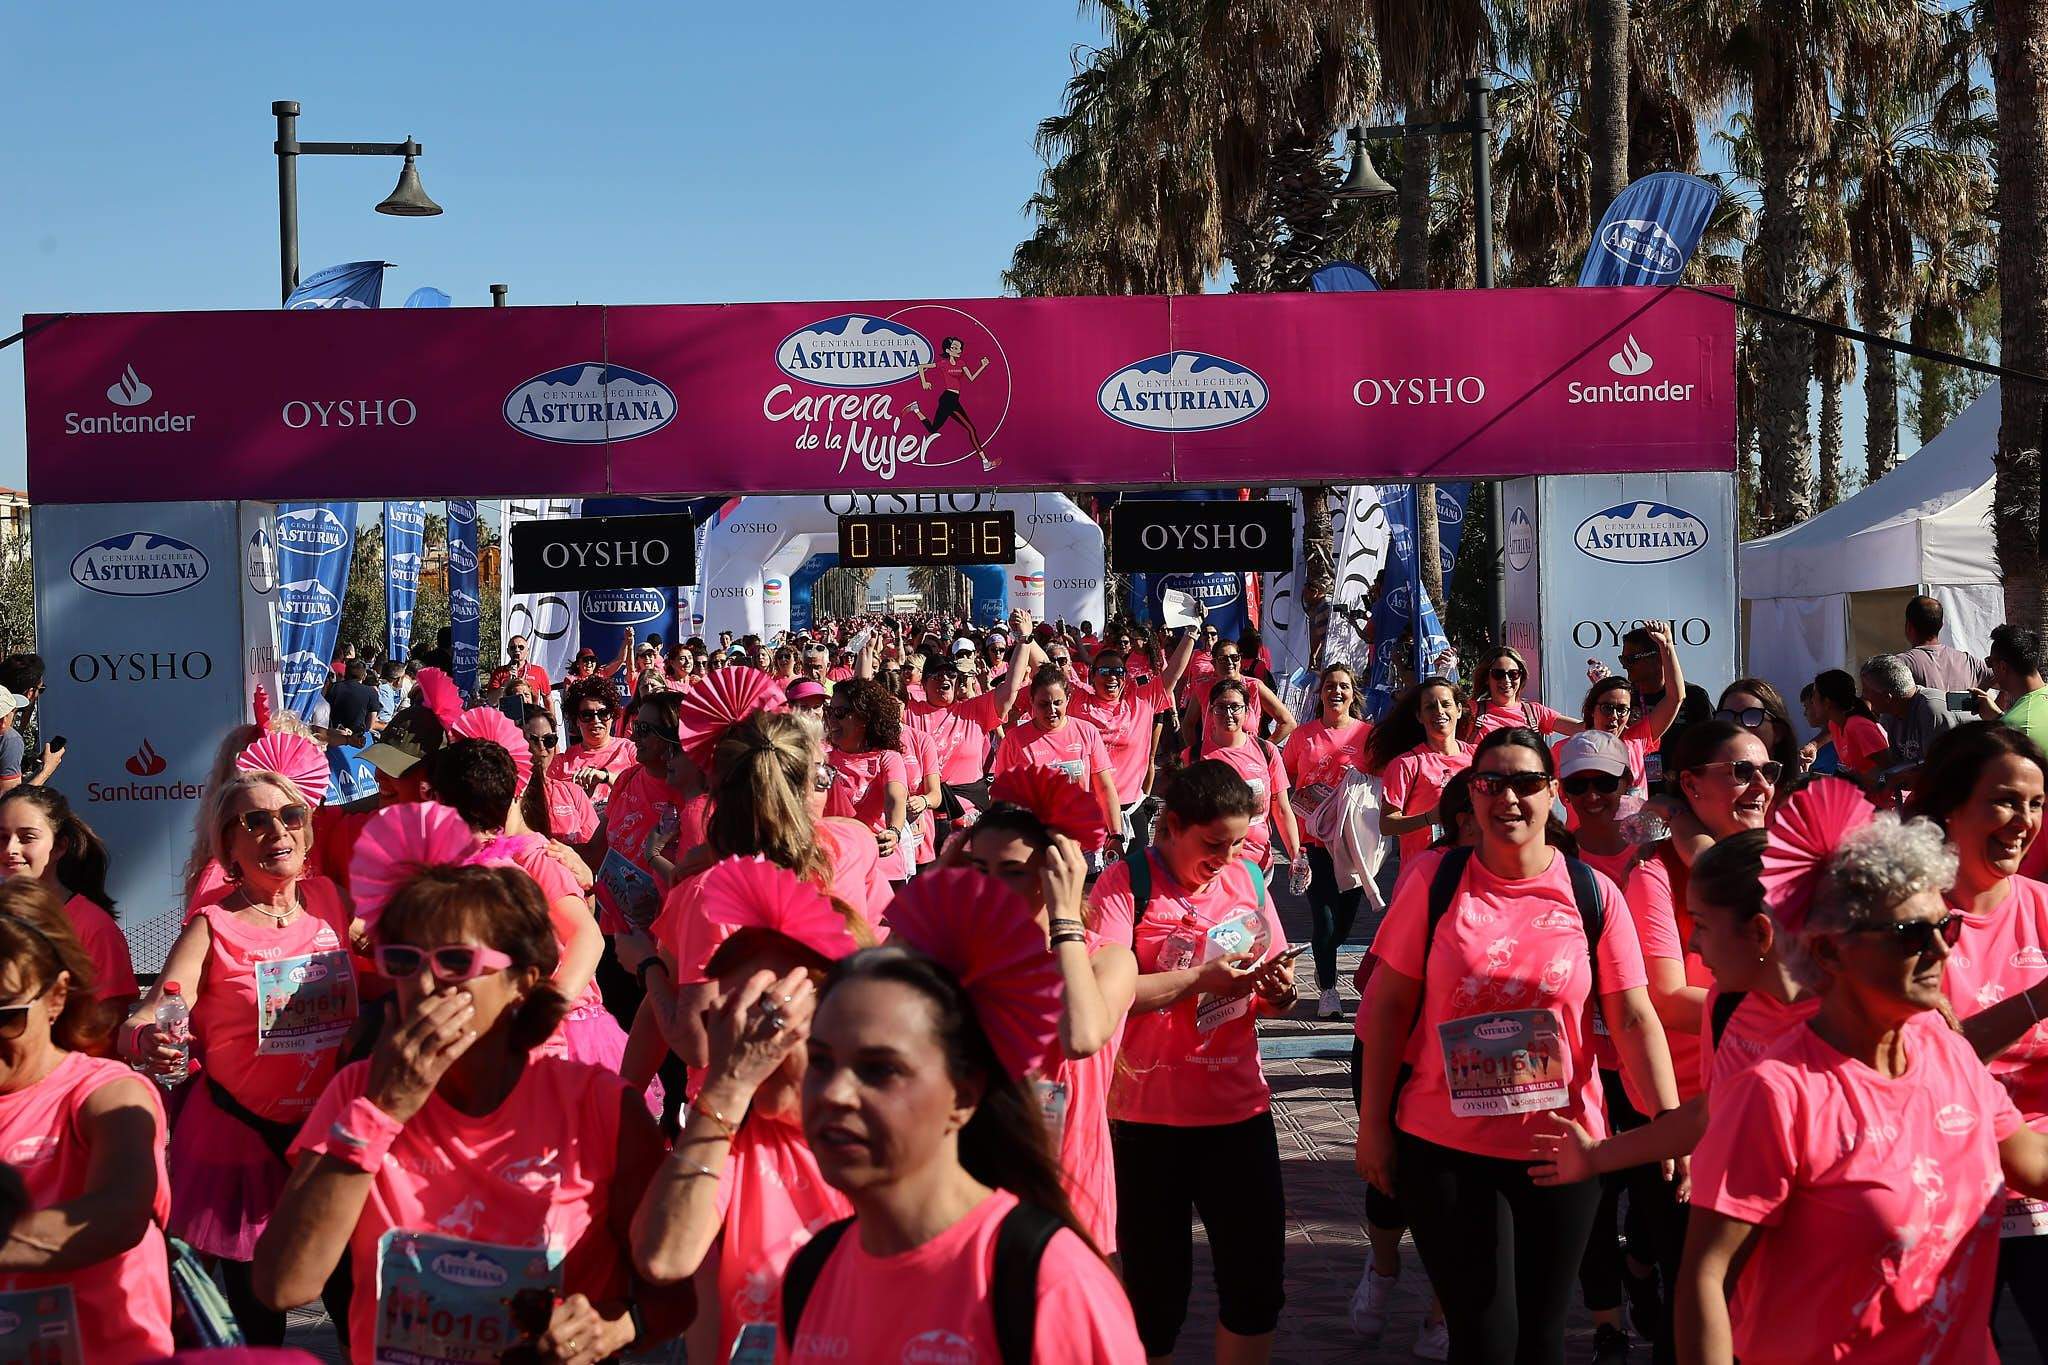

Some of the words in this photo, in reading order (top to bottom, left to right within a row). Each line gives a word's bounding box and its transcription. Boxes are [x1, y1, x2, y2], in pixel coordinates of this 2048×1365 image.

[788, 342, 920, 369] ASTURIANA
[811, 340, 861, 348] CENTRAL
[866, 339, 917, 347] LECHERA
[1137, 379, 1190, 388] CENTRAL
[1195, 378, 1249, 386] LECHERA
[1352, 376, 1486, 406] OYSHO
[1567, 380, 1695, 404] Santander
[543, 391, 598, 400] CENTRAL
[763, 384, 894, 421] Carrera
[1111, 382, 1256, 412] ASTURIANA
[282, 398, 417, 428] OYSHO
[516, 393, 665, 424] ASTURIANA
[64, 411, 196, 435] Santander
[795, 423, 820, 450] de
[824, 422, 842, 450] la
[838, 416, 942, 481] Mujer
[731, 523, 778, 534] OYSHO
[1027, 513, 1074, 524] OYSHO
[851, 520, 1001, 558] 01:13:16
[1141, 523, 1267, 551] OYSHO
[1584, 525, 1698, 549] ASTURIANA
[102, 554, 146, 562] CENTRAL
[150, 553, 194, 561] LECHERA
[542, 539, 670, 569] OYSHO
[81, 557, 199, 581] ASTURIANA
[710, 587, 754, 598] OYSHO
[1053, 578, 1097, 589] OYSHO
[584, 598, 660, 614] ASTURIANA
[1509, 621, 1535, 651] OYSHO
[1572, 617, 1711, 649] OYO
[69, 651, 212, 683] OYSHO
[250, 645, 279, 675] OYSHO
[87, 780, 205, 802] Santander
[271, 1039, 305, 1049] OYSHO
[1484, 1052, 1526, 1074] 016
[1502, 1085, 1524, 1095] MUJER
[1528, 1081, 1558, 1091] VALENCIA
[1463, 1100, 1498, 1111] OYSHO
[432, 1310, 500, 1343] 016
